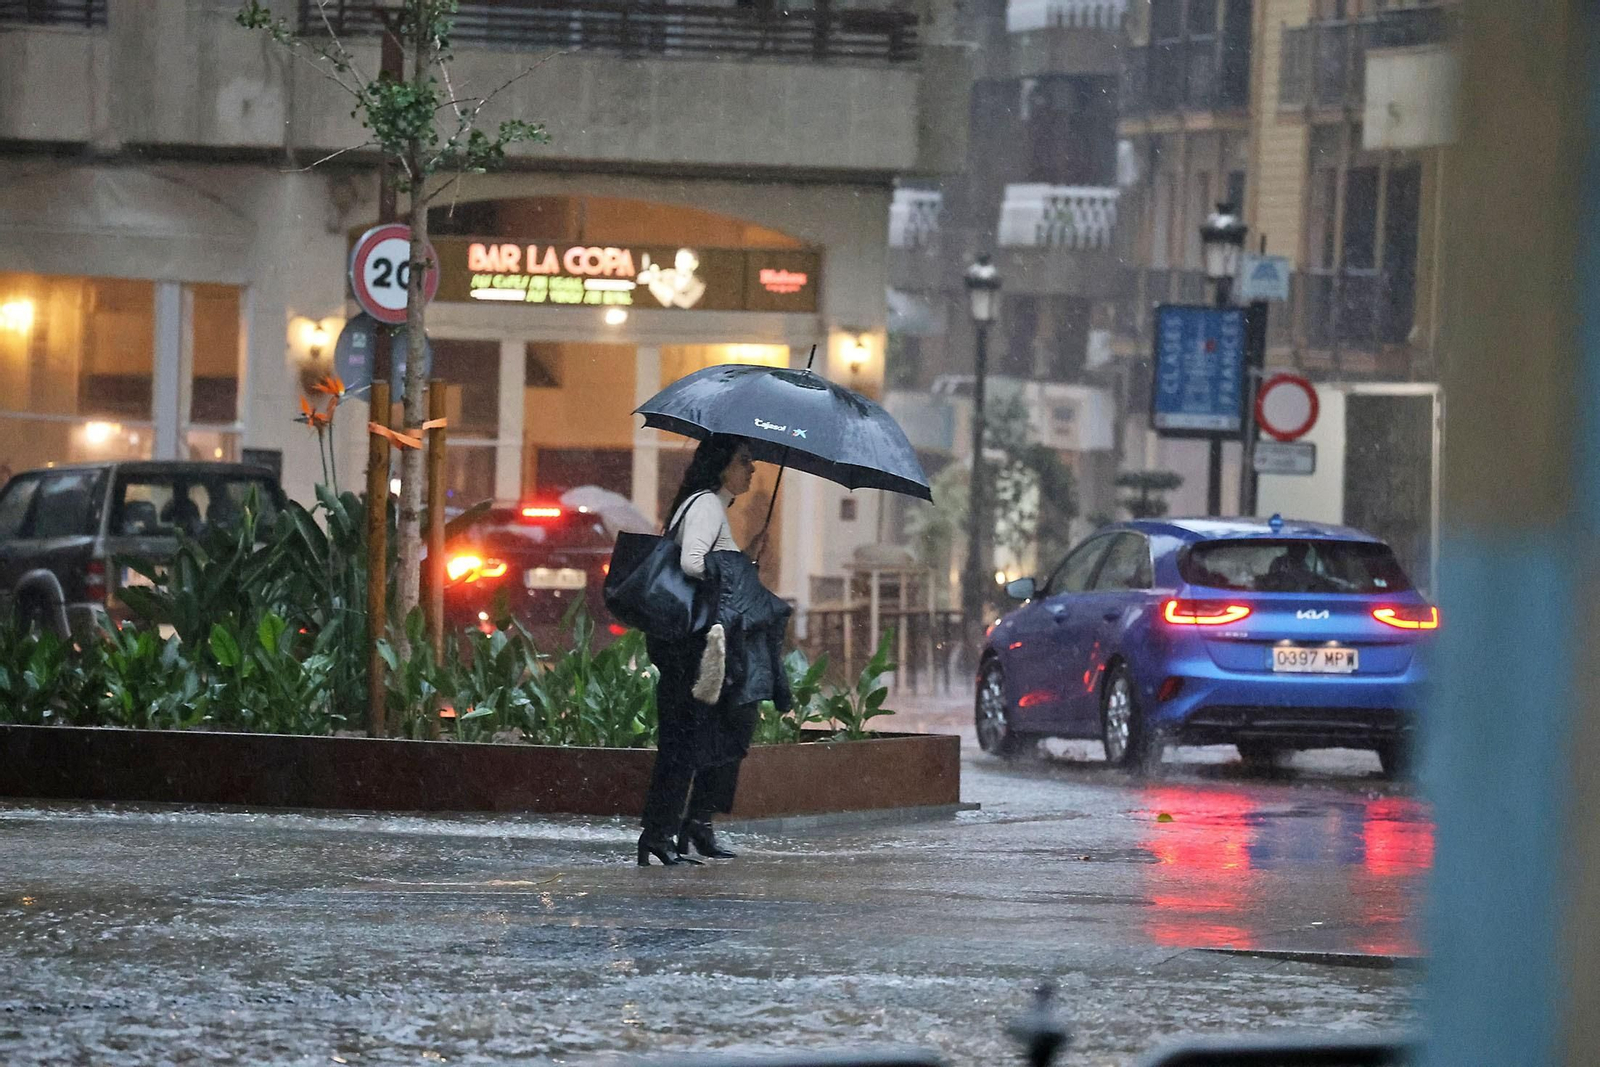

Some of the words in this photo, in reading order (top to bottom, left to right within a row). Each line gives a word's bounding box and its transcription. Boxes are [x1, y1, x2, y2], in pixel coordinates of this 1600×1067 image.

[468, 243, 522, 272] BAR
[526, 244, 560, 274] LA
[563, 246, 636, 277] COPA
[1296, 610, 1329, 619] KIA
[1277, 651, 1318, 666] 0397
